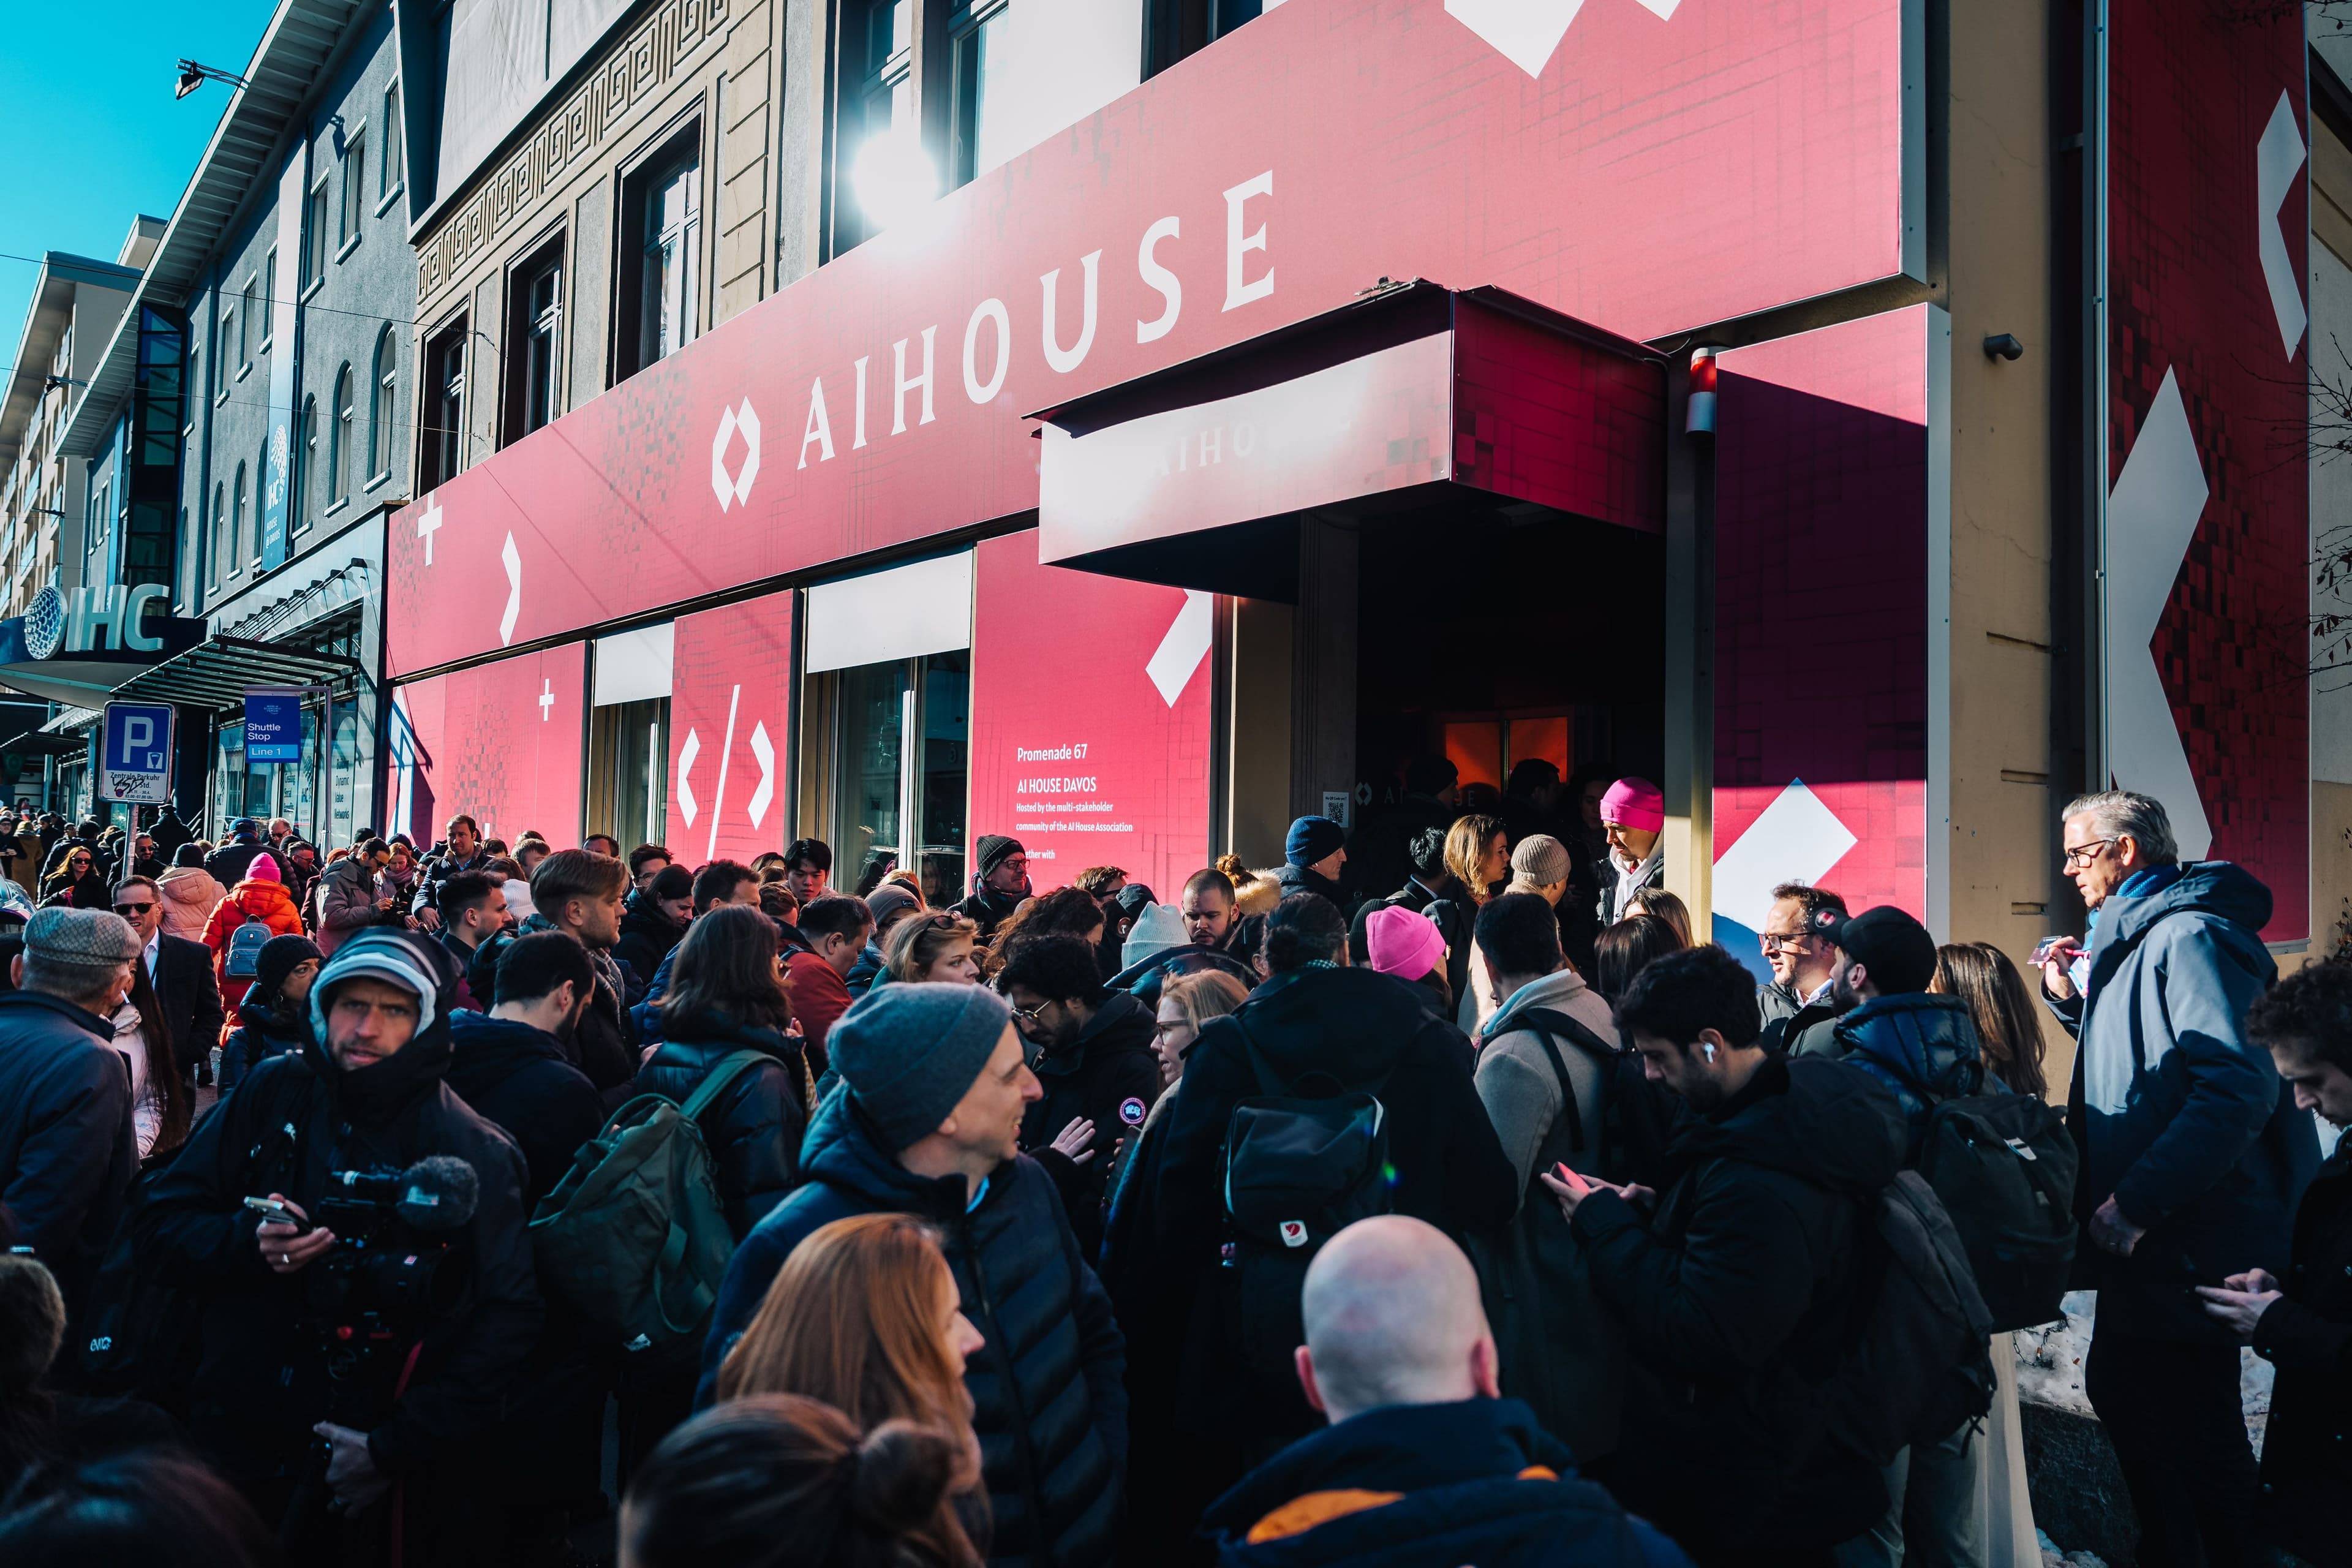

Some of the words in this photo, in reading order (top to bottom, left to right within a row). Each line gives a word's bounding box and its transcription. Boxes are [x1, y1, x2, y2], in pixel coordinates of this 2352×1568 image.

[268, 479, 279, 511] IHC
[66, 583, 170, 652] IHC
[123, 715, 153, 763] P
[247, 732, 271, 742] Stop
[1017, 743, 1072, 762] Promenade
[1074, 744, 1087, 759] 67
[1017, 778, 1027, 793] AI
[1029, 777, 1061, 793] HOUSE
[1063, 776, 1096, 793] DAVOS
[1016, 802, 1036, 812] Hosted
[1037, 802, 1045, 813] by
[1045, 802, 1055, 812] the
[1057, 801, 1114, 812] multi-stakeholder
[1016, 821, 1049, 833] community
[1049, 821, 1057, 831] of
[1057, 821, 1067, 831] the
[1068, 822, 1074, 831] AI
[1075, 822, 1095, 831] House
[1095, 822, 1133, 832] Association
[1041, 850, 1055, 859] with
